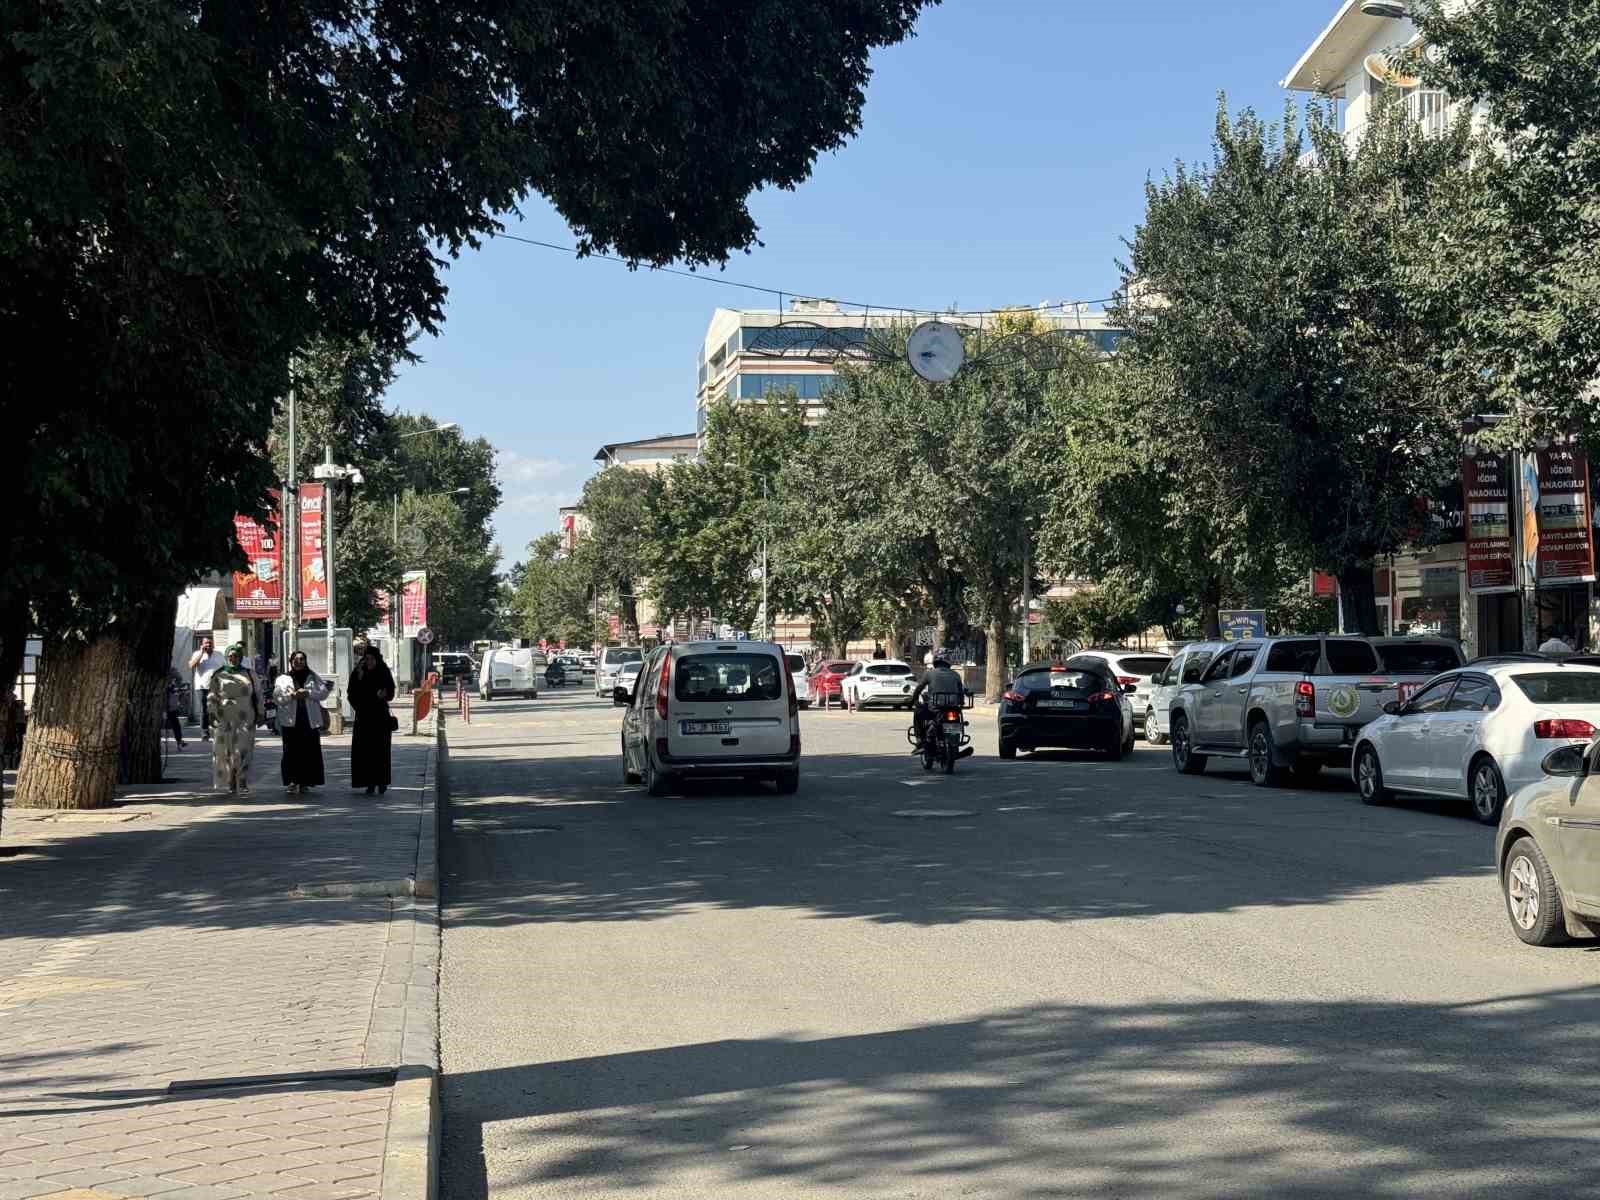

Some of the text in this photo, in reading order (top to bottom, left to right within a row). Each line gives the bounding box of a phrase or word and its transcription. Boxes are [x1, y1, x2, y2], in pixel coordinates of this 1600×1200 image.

[1548, 452, 1573, 460] YA-PA
[1477, 460, 1498, 468] YA-PA
[1541, 480, 1585, 489] ANAOKULU
[1468, 488, 1508, 497] ANAOKULU
